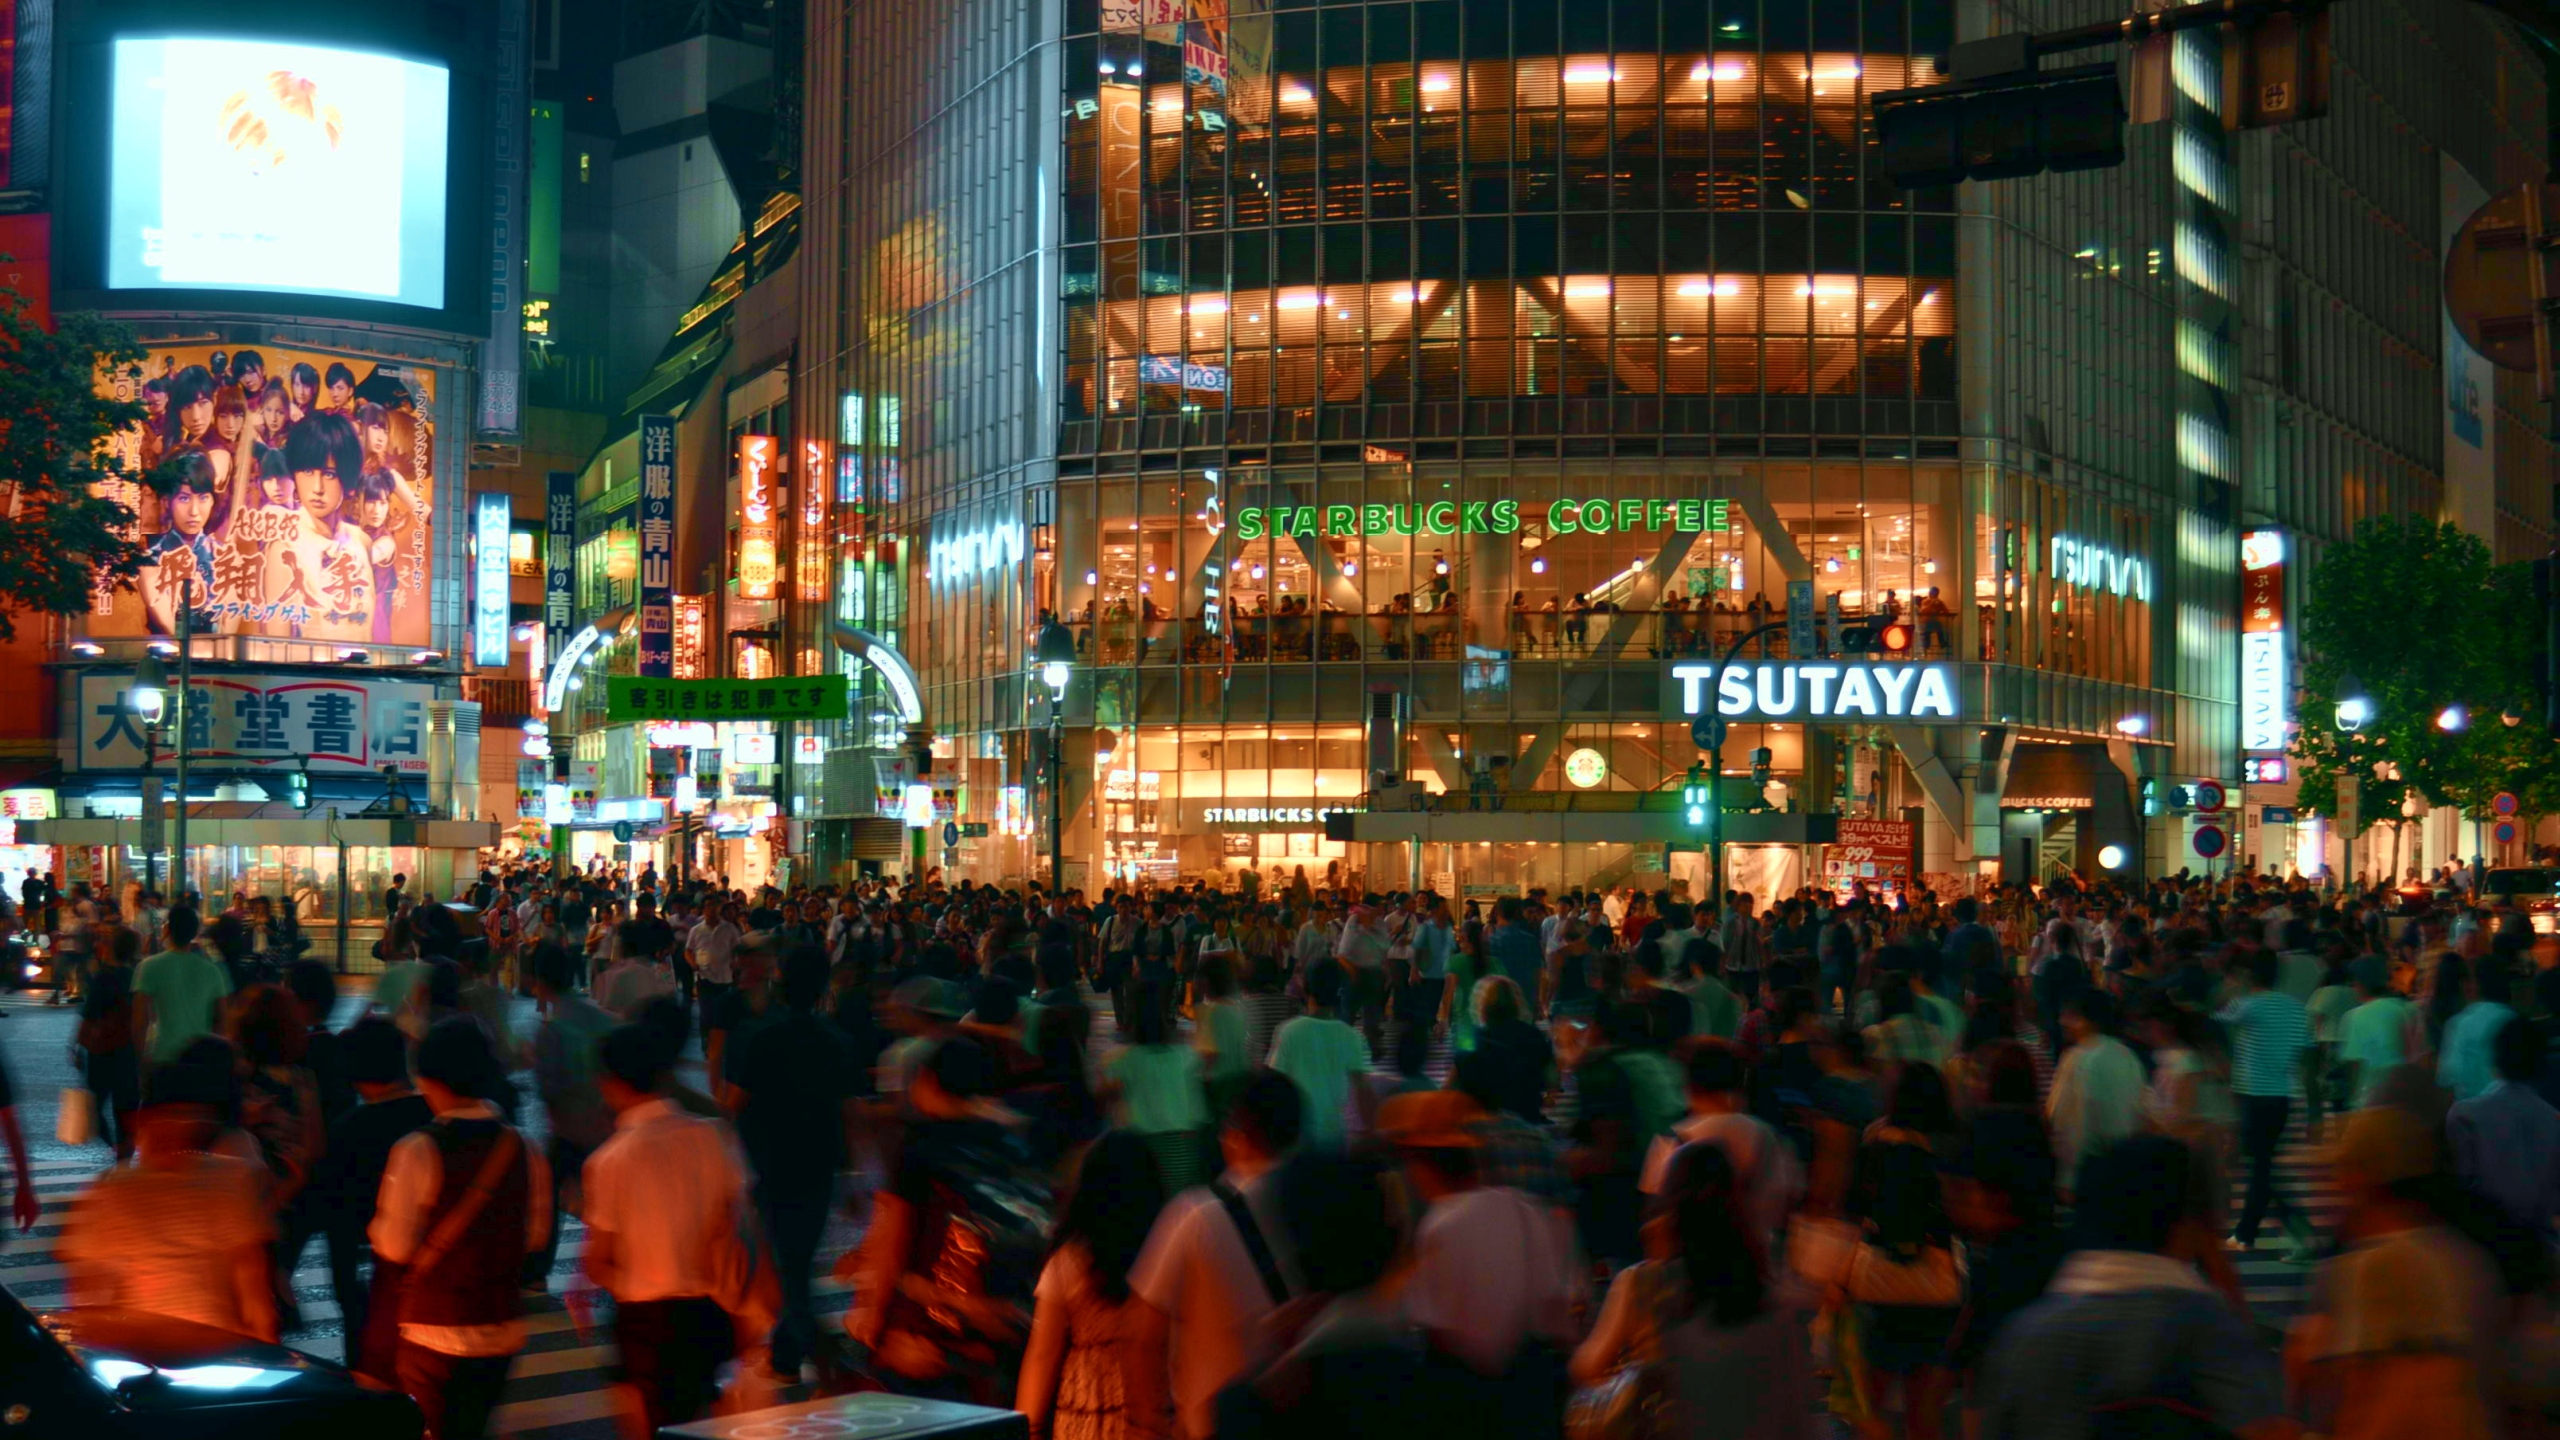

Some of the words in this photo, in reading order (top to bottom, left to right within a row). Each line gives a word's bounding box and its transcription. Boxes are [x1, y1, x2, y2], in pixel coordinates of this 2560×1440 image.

[229, 507, 300, 542] AKB48
[642, 426, 672, 589] 洋服の青山
[1237, 500, 1519, 540] STARBUCKS
[1548, 497, 1729, 534] COFFEE
[548, 494, 573, 666] 洋服の青山
[211, 602, 311, 623] フライングゲット
[630, 687, 826, 710] 客引きは犯罪です
[1672, 665, 1955, 716] TSUTAYA
[2253, 635, 2270, 747] TSUTAYA
[1203, 808, 1313, 823] STARBUCKS
[2045, 797, 2092, 808] COFFEE
